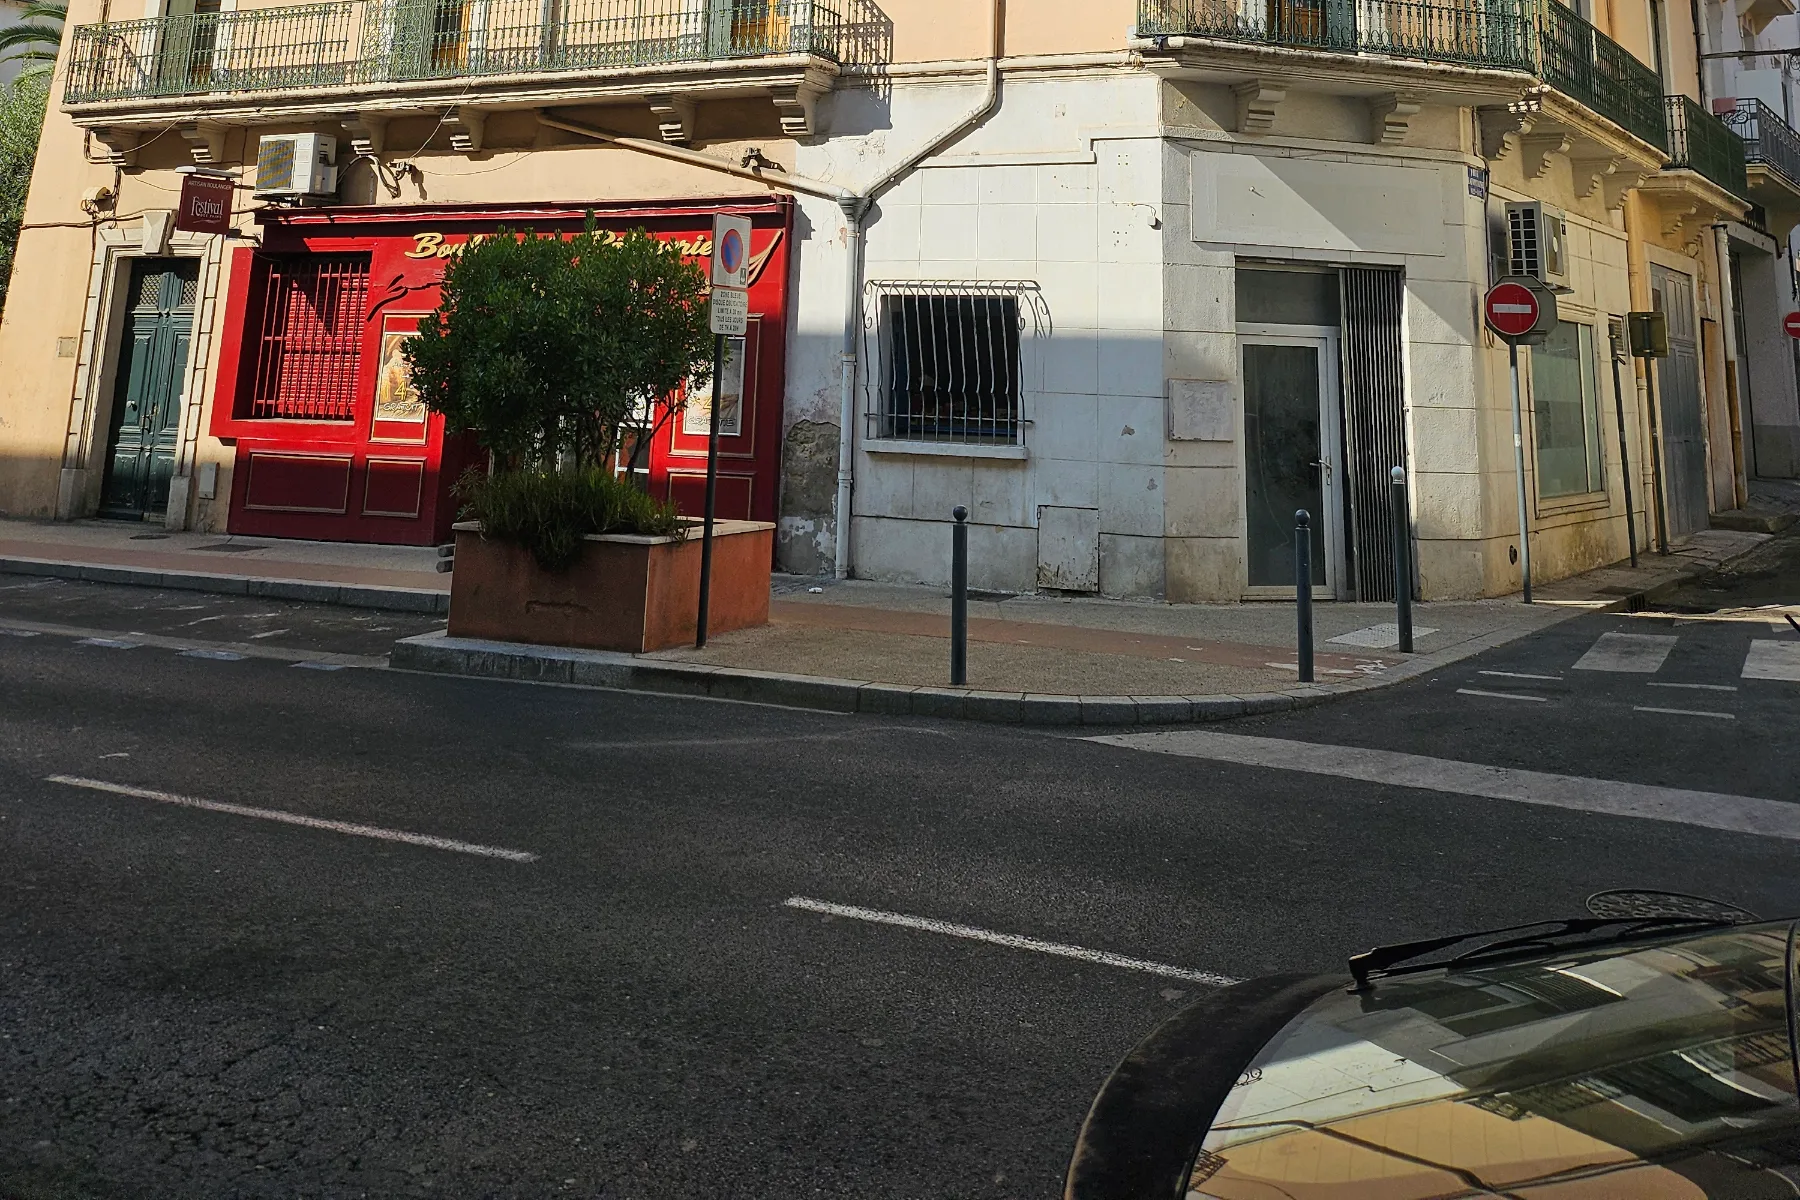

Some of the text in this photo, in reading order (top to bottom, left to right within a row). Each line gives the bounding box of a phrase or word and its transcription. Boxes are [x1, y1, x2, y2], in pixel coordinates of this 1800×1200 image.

[187, 180, 232, 190] ARTISAN BOULANGER
[191, 196, 224, 217] Festival
